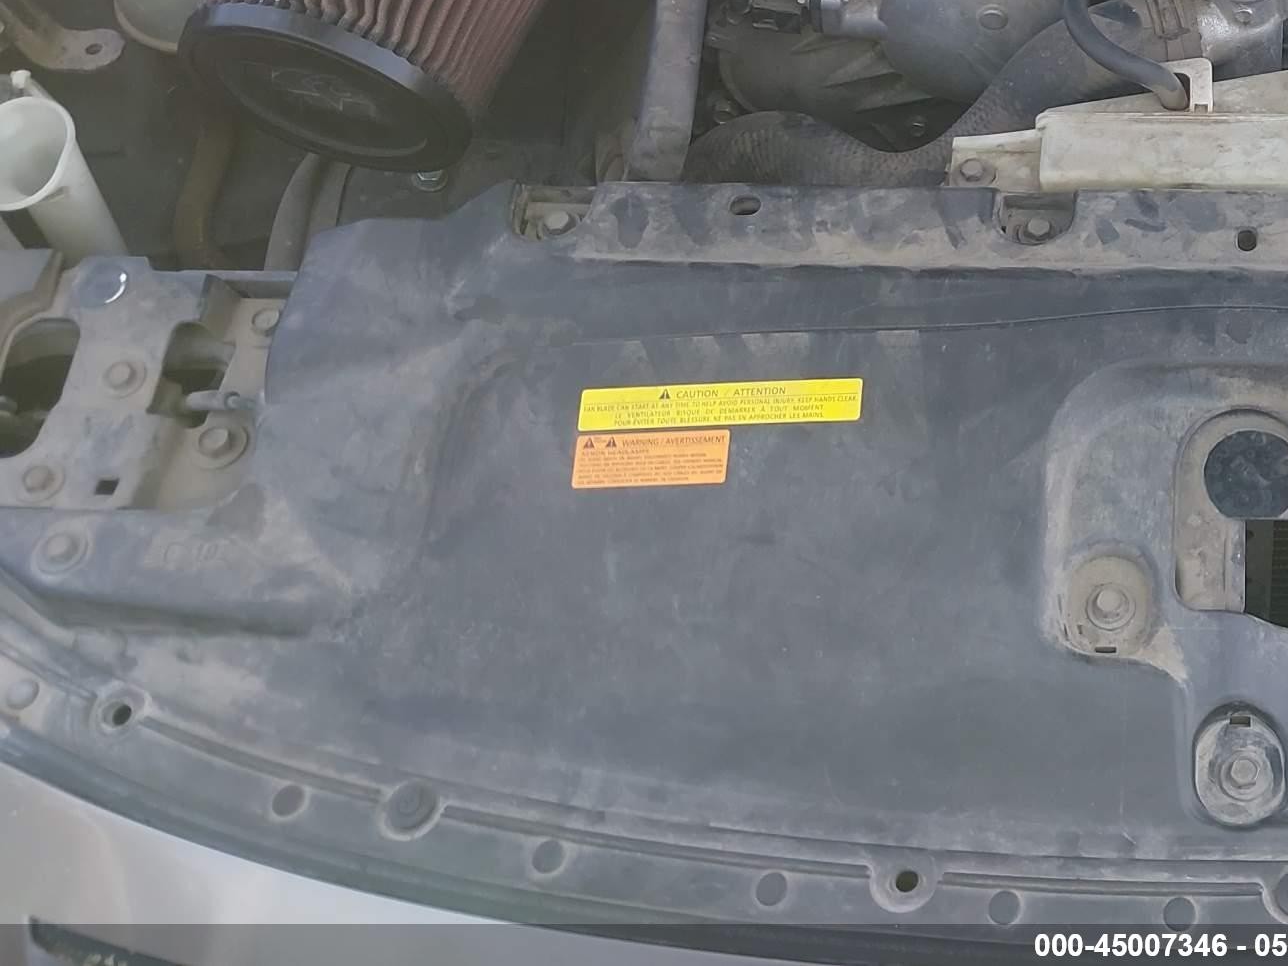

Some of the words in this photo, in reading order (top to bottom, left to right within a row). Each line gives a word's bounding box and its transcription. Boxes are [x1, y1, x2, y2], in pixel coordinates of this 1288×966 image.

[676, 389, 719, 400] CAUTION
[734, 386, 786, 397] ATTENTION
[740, 398, 770, 406] PERSONAL
[628, 410, 671, 418] VENTILATEUR
[622, 438, 660, 447] WARNING
[666, 436, 726, 445] AVERTISSEMENT
